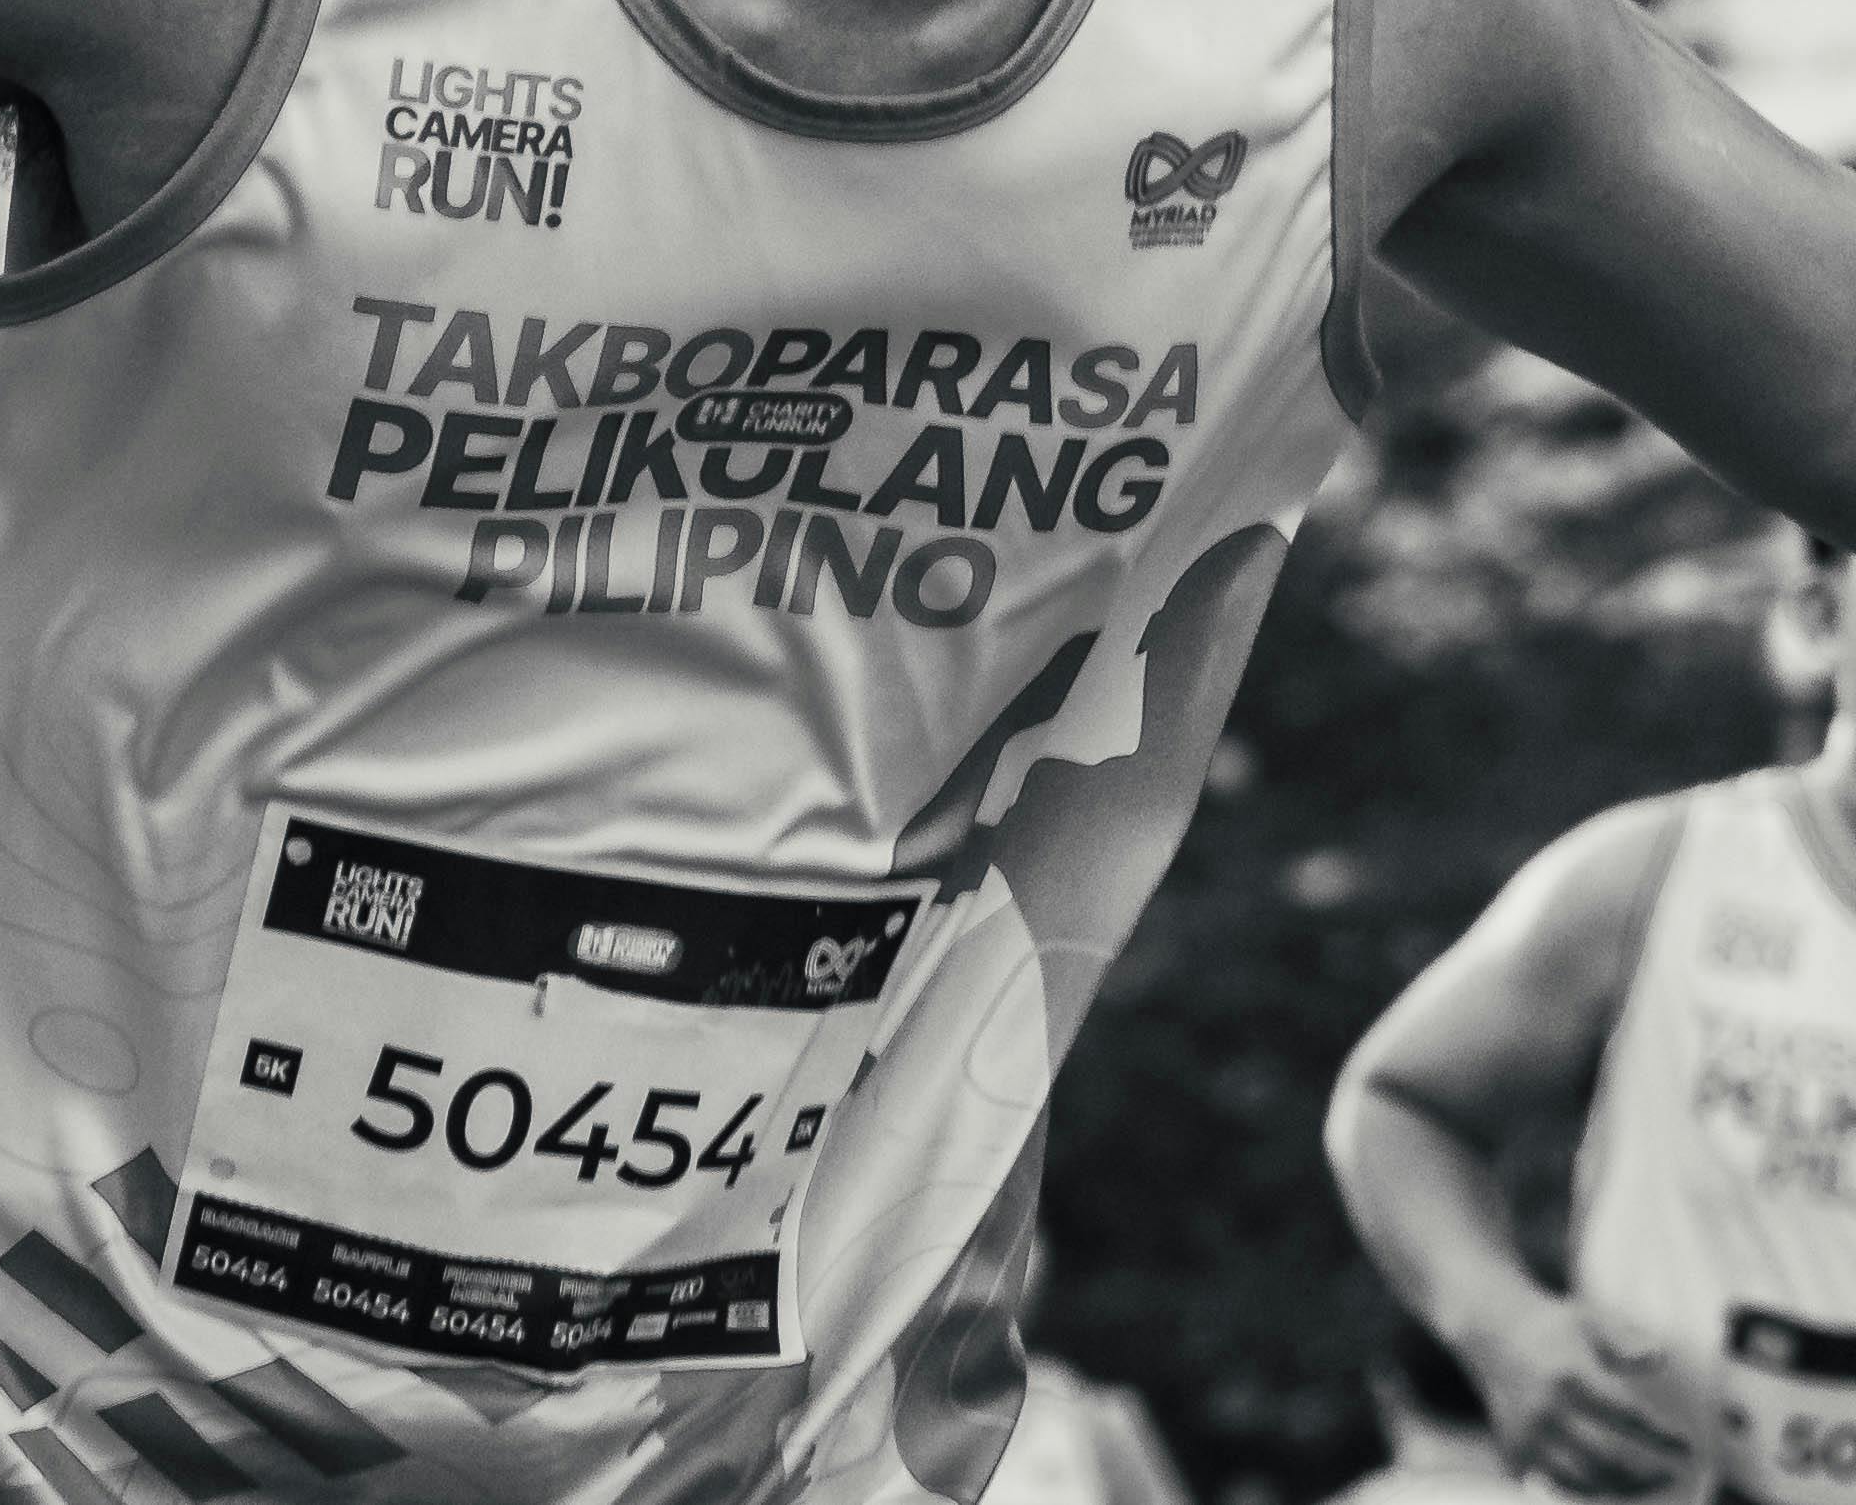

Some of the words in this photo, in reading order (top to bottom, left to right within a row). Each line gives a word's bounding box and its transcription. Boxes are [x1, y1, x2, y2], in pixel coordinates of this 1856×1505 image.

[388, 58, 584, 122] LIGHTS
[386, 106, 573, 159] CAMERA
[374, 143, 569, 230] RUN!
[1132, 201, 1217, 228] MYRIAD
[349, 295, 1199, 429] TAKBOPARASA
[742, 416, 828, 437] FUNRUN
[748, 399, 842, 421] CHARITY
[326, 397, 1171, 534] PELIKULANG
[455, 509, 999, 629] PILIPINO
[322, 895, 417, 950] RUN!
[254, 1053, 292, 1084] 5K
[350, 1042, 764, 1189] 50454
[191, 1244, 290, 1293] 50454
[313, 1277, 411, 1325] 50454
[429, 1305, 527, 1345] 50454
